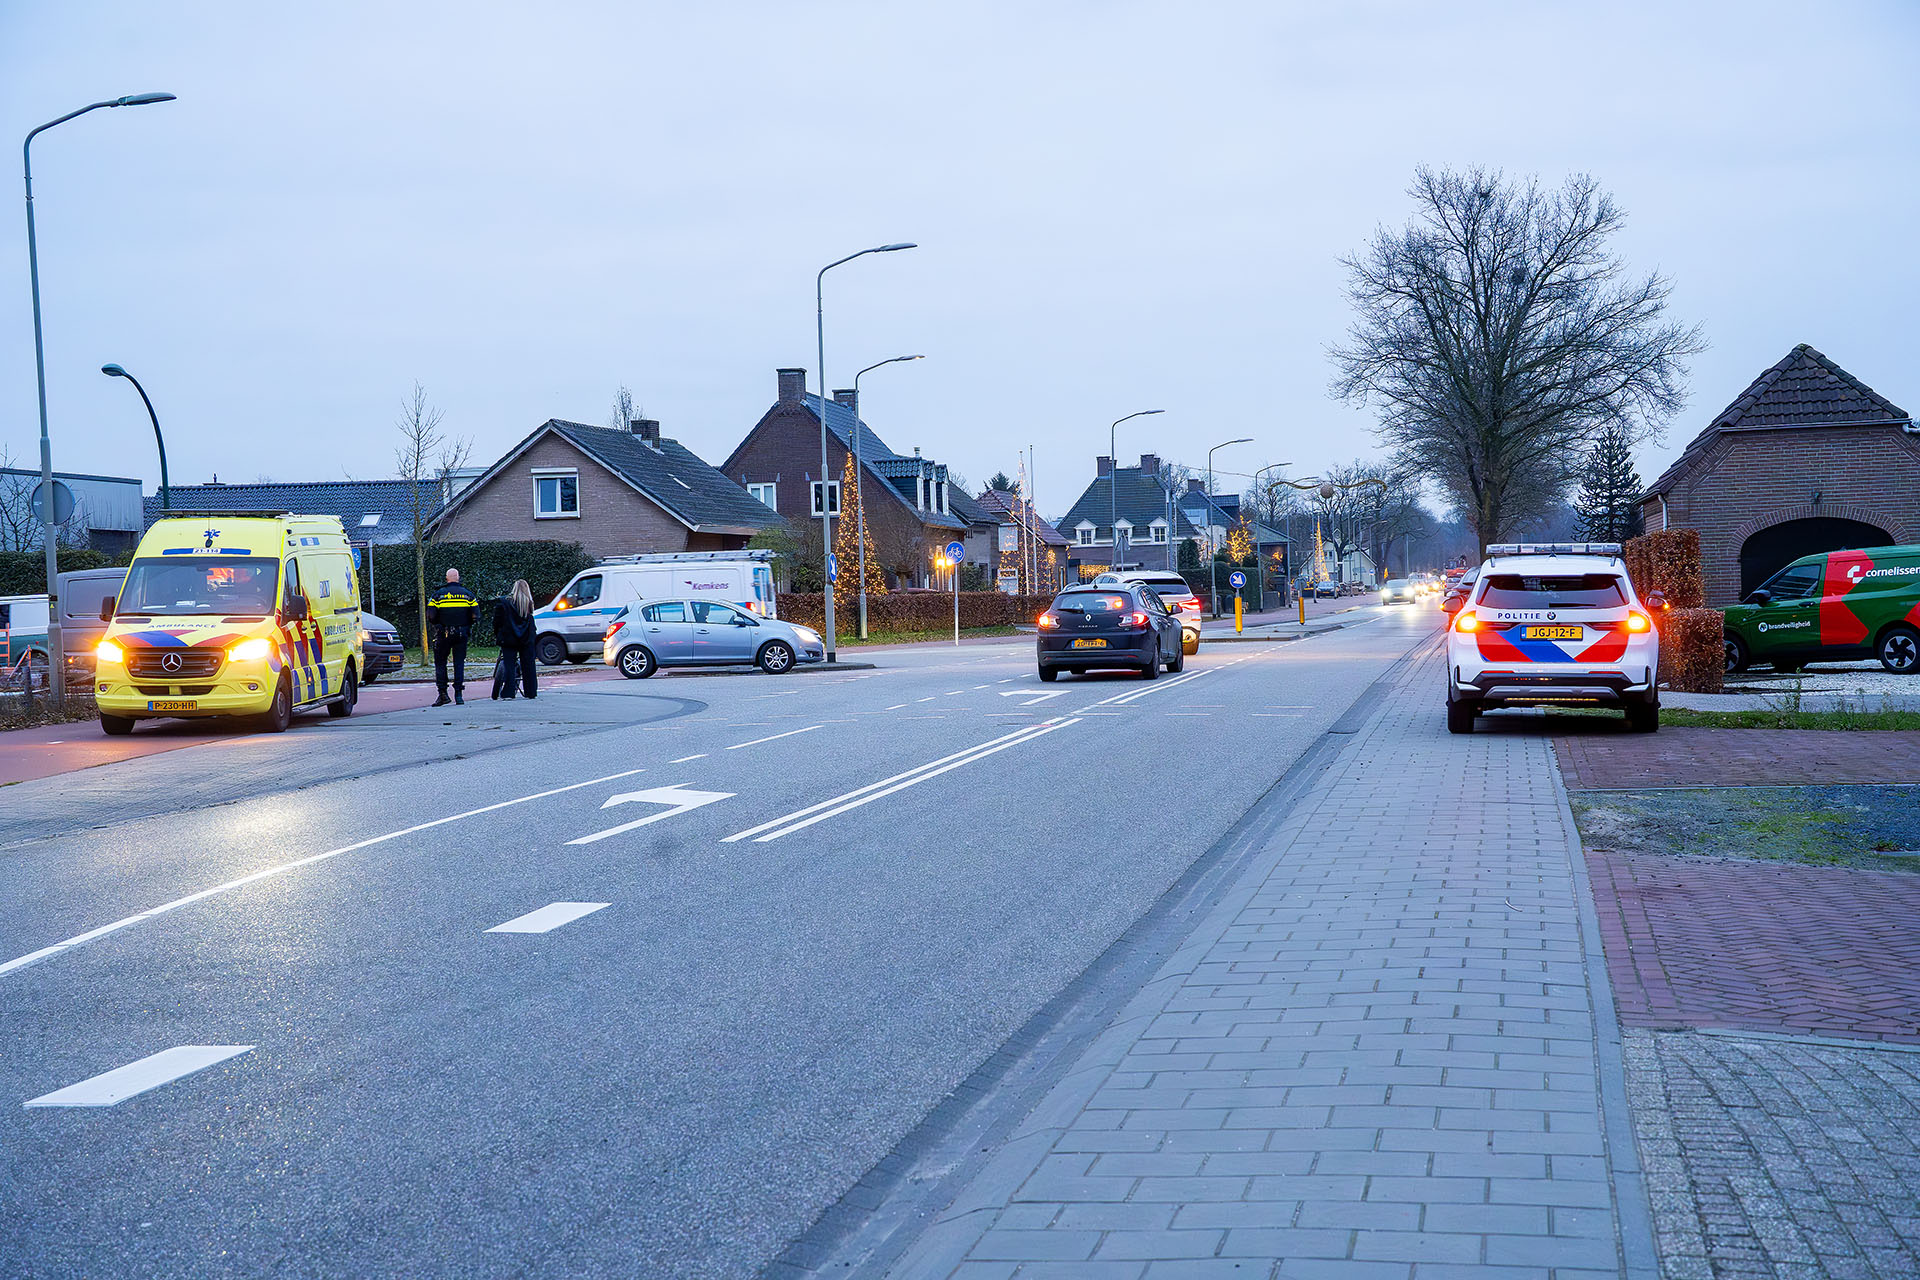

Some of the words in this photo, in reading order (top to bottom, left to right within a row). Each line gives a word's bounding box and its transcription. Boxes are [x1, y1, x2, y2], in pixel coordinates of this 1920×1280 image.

[1497, 612, 1541, 620] POLITIE
[1768, 620, 1811, 630] brandveiligheid
[1532, 628, 1576, 638] JGJ-12-F
[154, 702, 194, 710] P-230-HH
